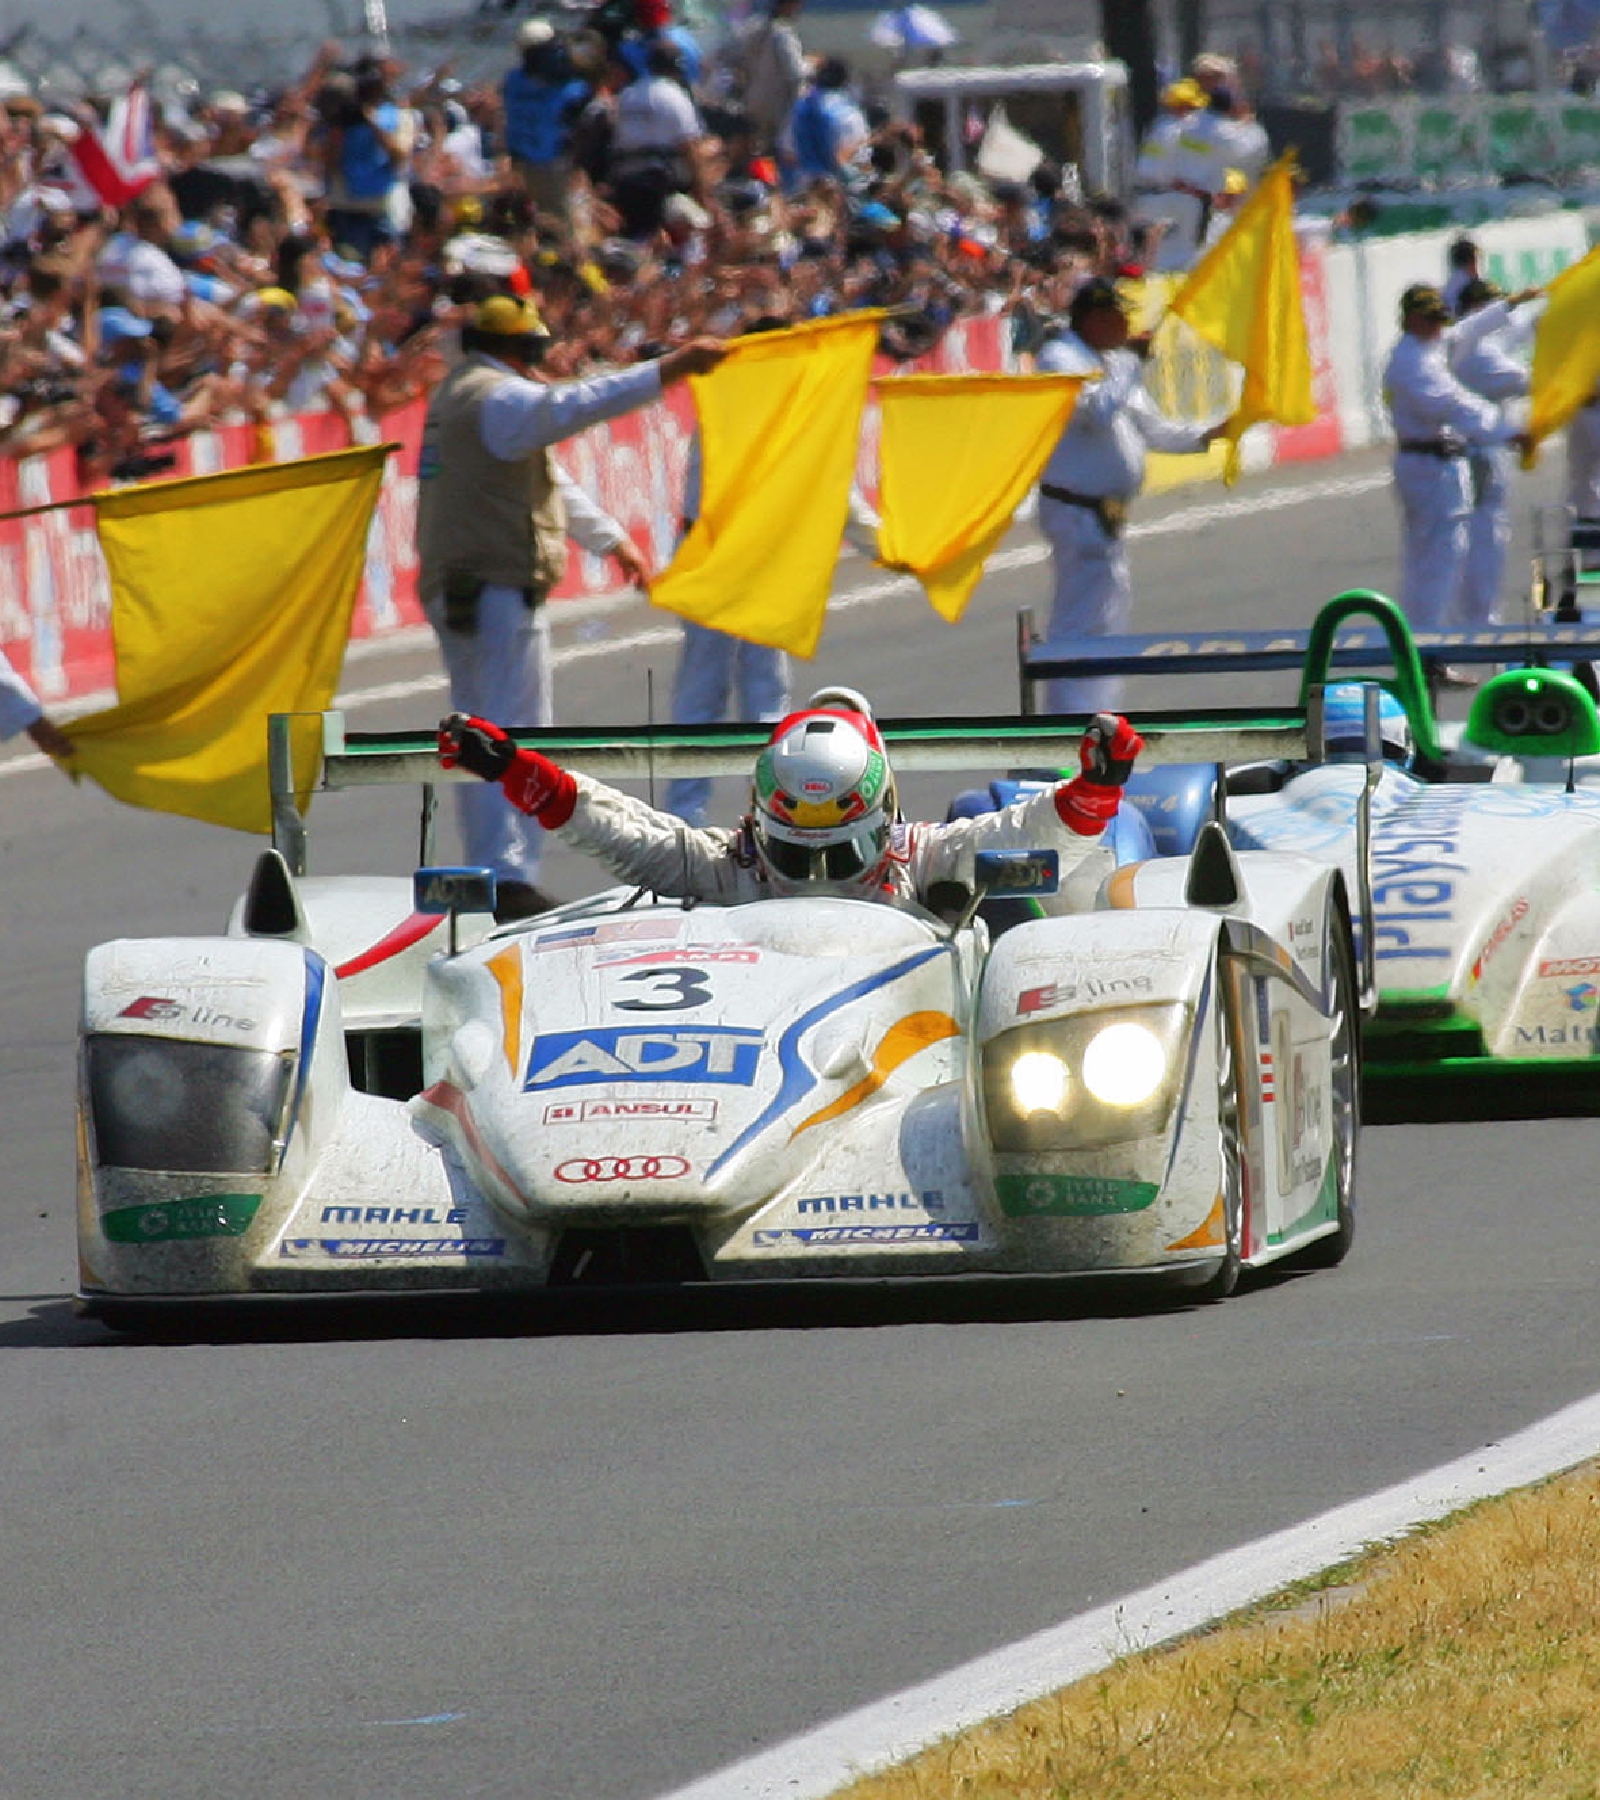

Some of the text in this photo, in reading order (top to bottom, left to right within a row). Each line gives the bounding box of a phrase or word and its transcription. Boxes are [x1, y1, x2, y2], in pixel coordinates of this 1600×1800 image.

[611, 966, 714, 1012] 3
[191, 1005, 256, 1031] line
[526, 1032, 767, 1085] ADT
[590, 1103, 703, 1116] ANSUL
[797, 1189, 945, 1214] MAHLE
[320, 1206, 470, 1225] MAHLE
[810, 1226, 969, 1242] MICHELIN
[335, 1239, 494, 1257] MICHELIN
